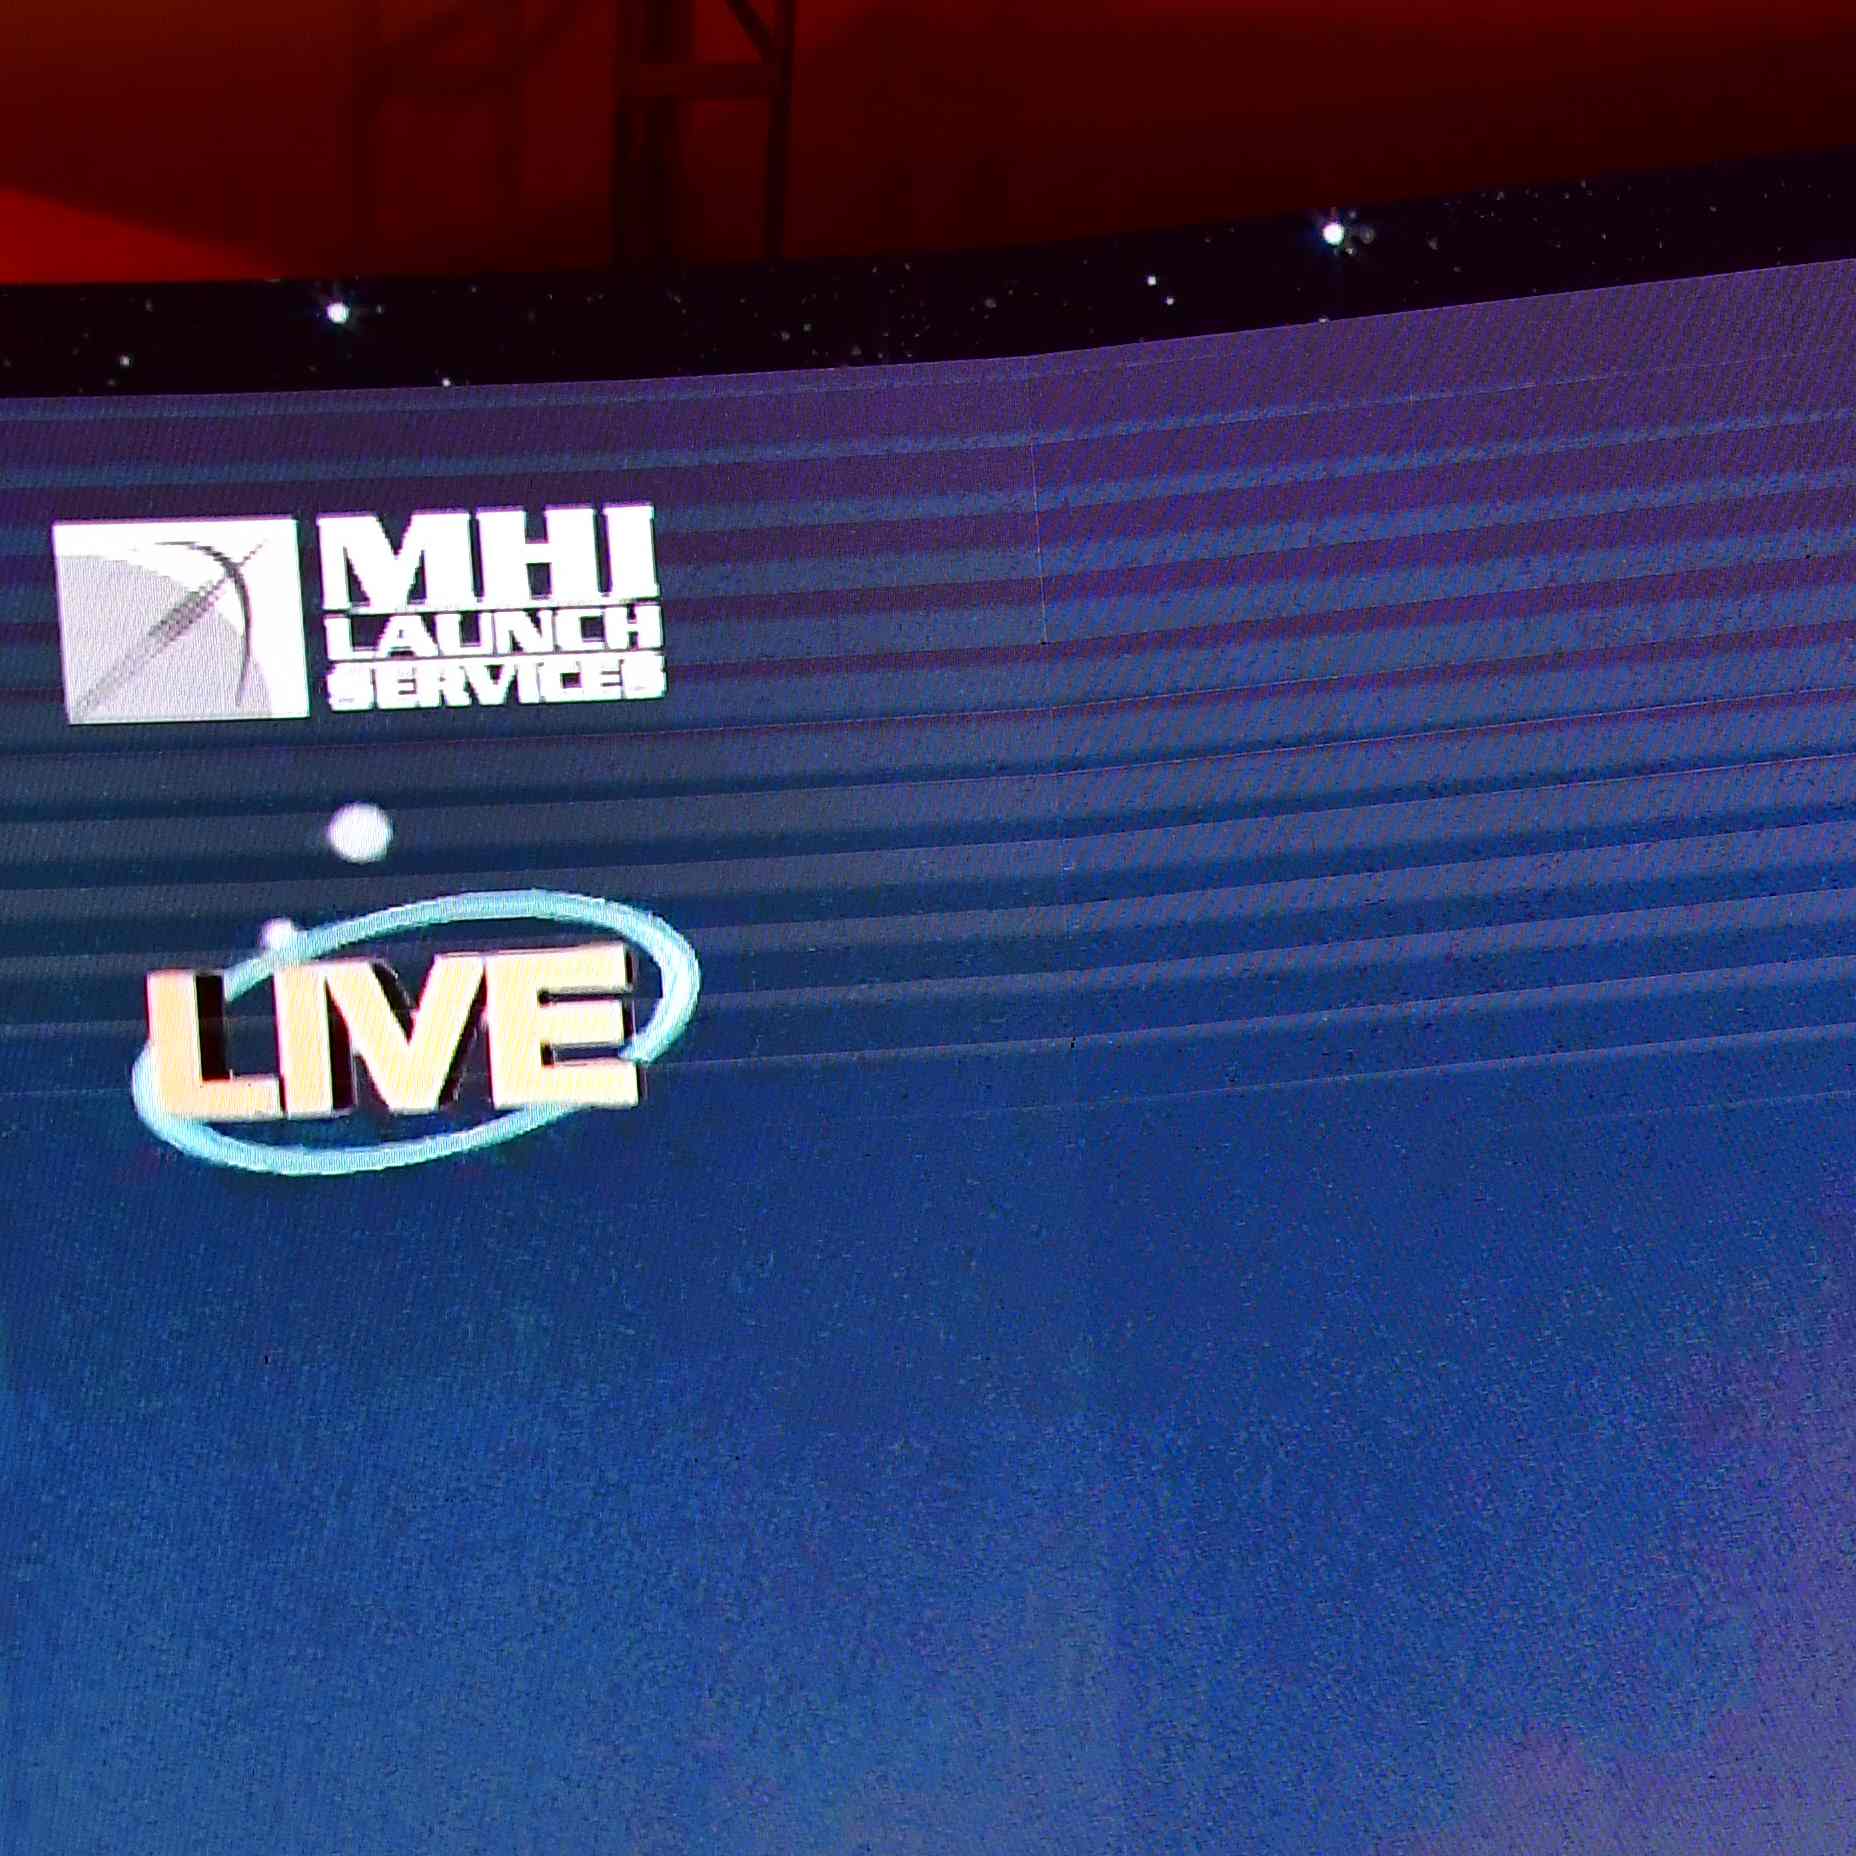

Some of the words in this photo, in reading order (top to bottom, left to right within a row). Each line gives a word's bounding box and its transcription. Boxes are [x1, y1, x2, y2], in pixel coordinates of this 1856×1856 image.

[317, 503, 660, 611] MHI
[323, 602, 663, 661] LAUNCH
[328, 652, 667, 711] SERVICES
[146, 942, 642, 1122] LIVE
